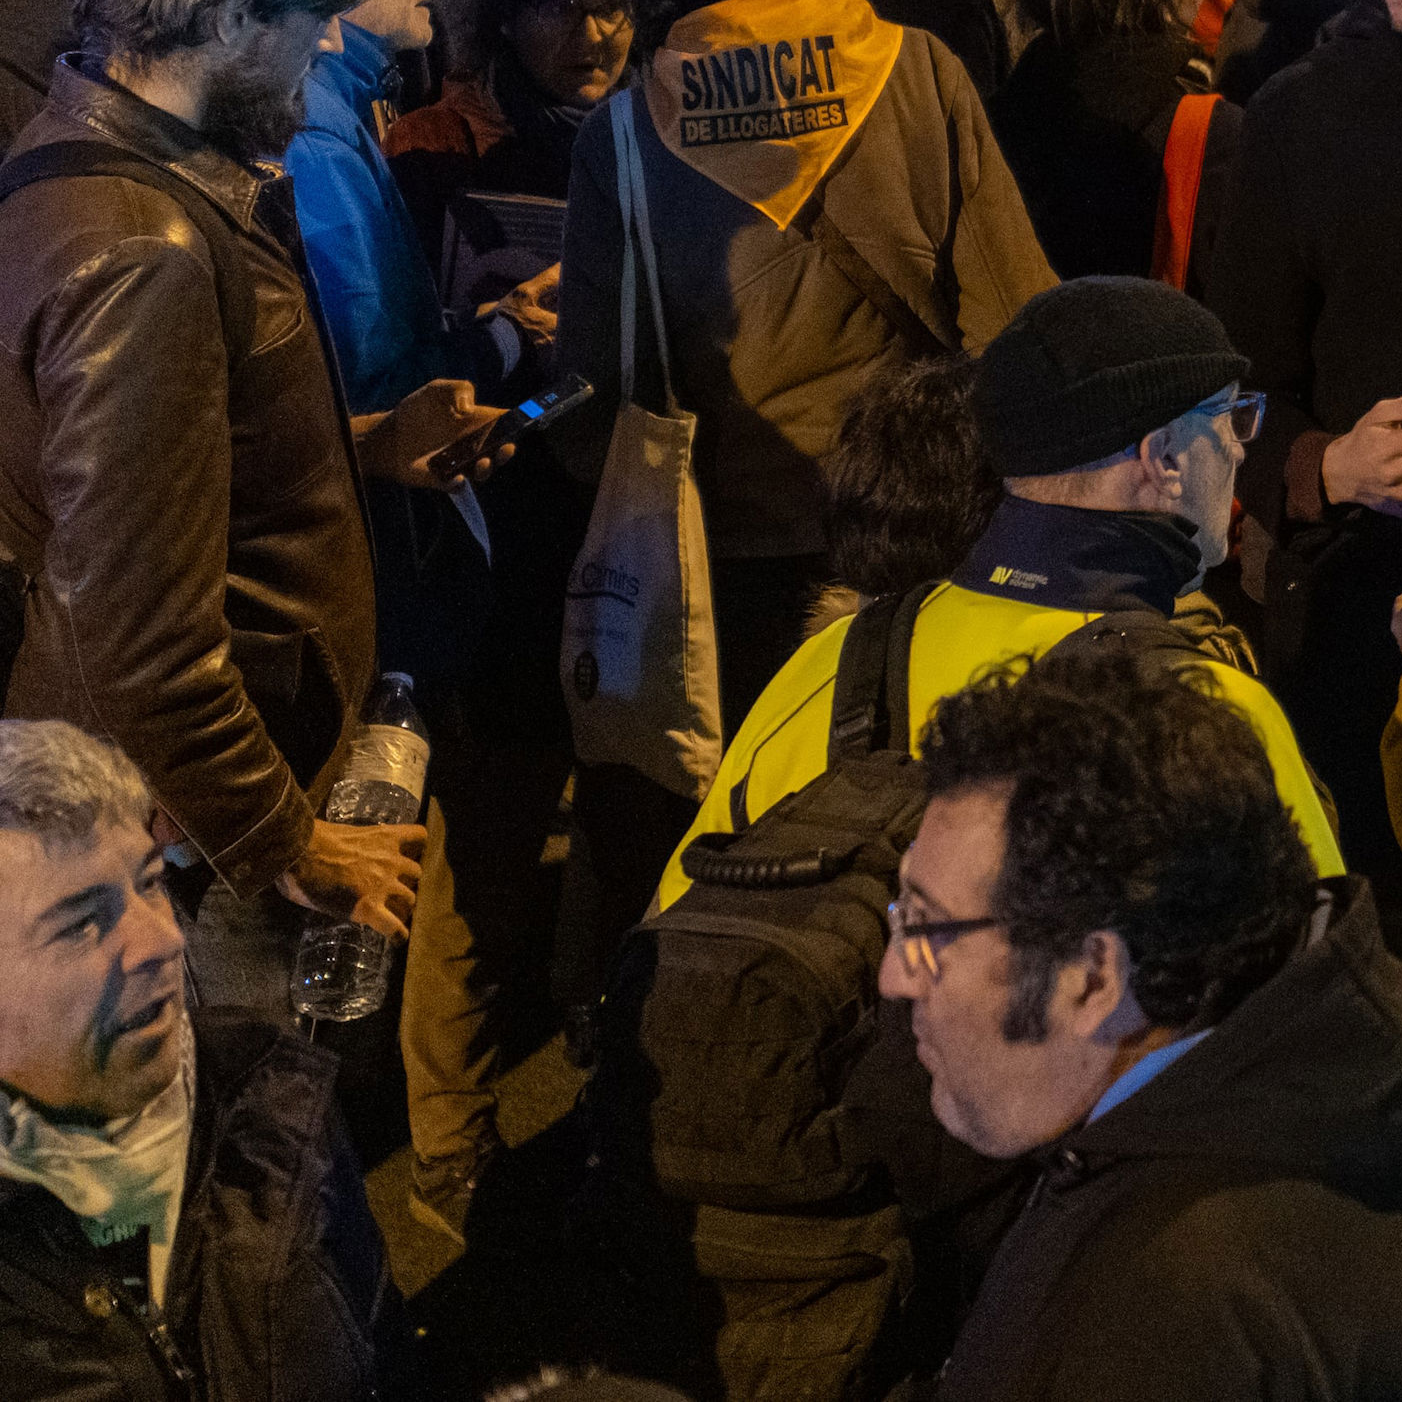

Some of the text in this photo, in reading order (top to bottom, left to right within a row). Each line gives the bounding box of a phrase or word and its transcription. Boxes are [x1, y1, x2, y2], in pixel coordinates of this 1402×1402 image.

[681, 35, 835, 111] SINDICAT
[685, 103, 843, 144] DE LLOGATERES
